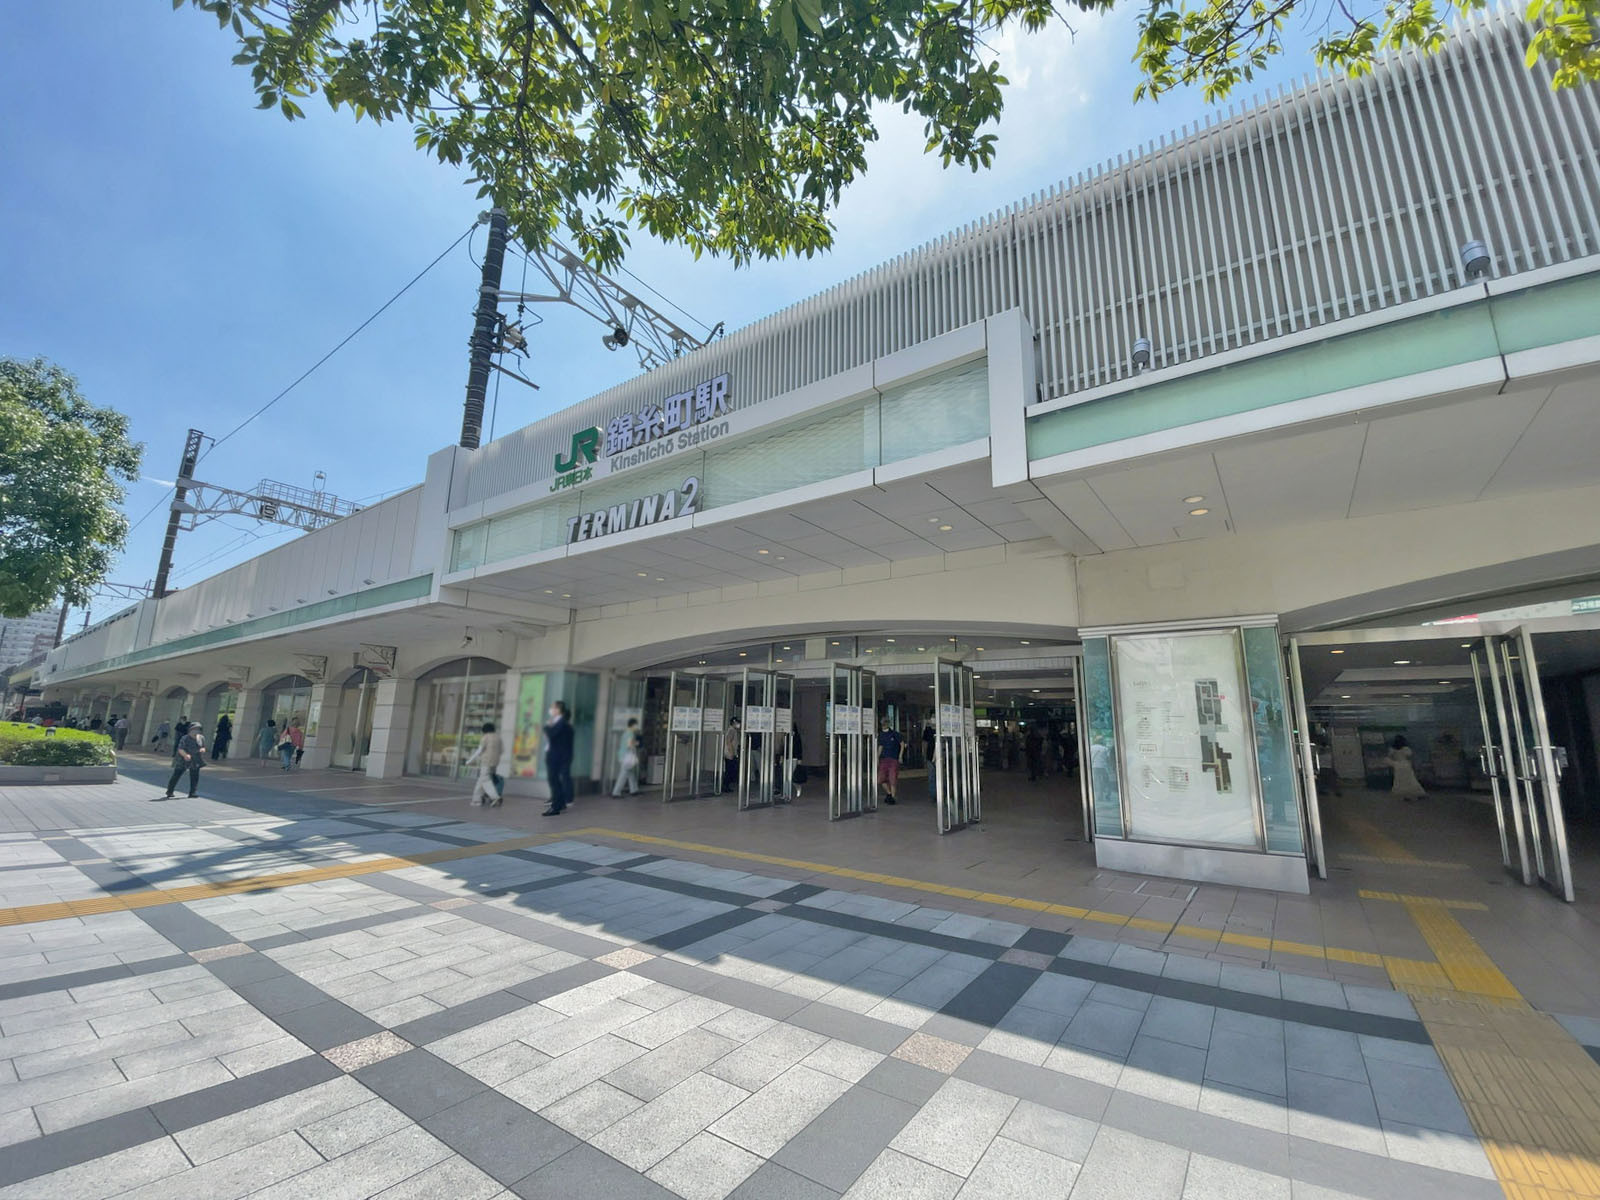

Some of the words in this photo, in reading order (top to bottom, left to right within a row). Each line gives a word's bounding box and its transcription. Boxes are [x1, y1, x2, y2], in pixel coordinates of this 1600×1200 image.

[606, 372, 731, 458] 錦糸町駅
[555, 426, 599, 474] JR
[677, 421, 729, 450] Station
[549, 466, 593, 492] JR東日本
